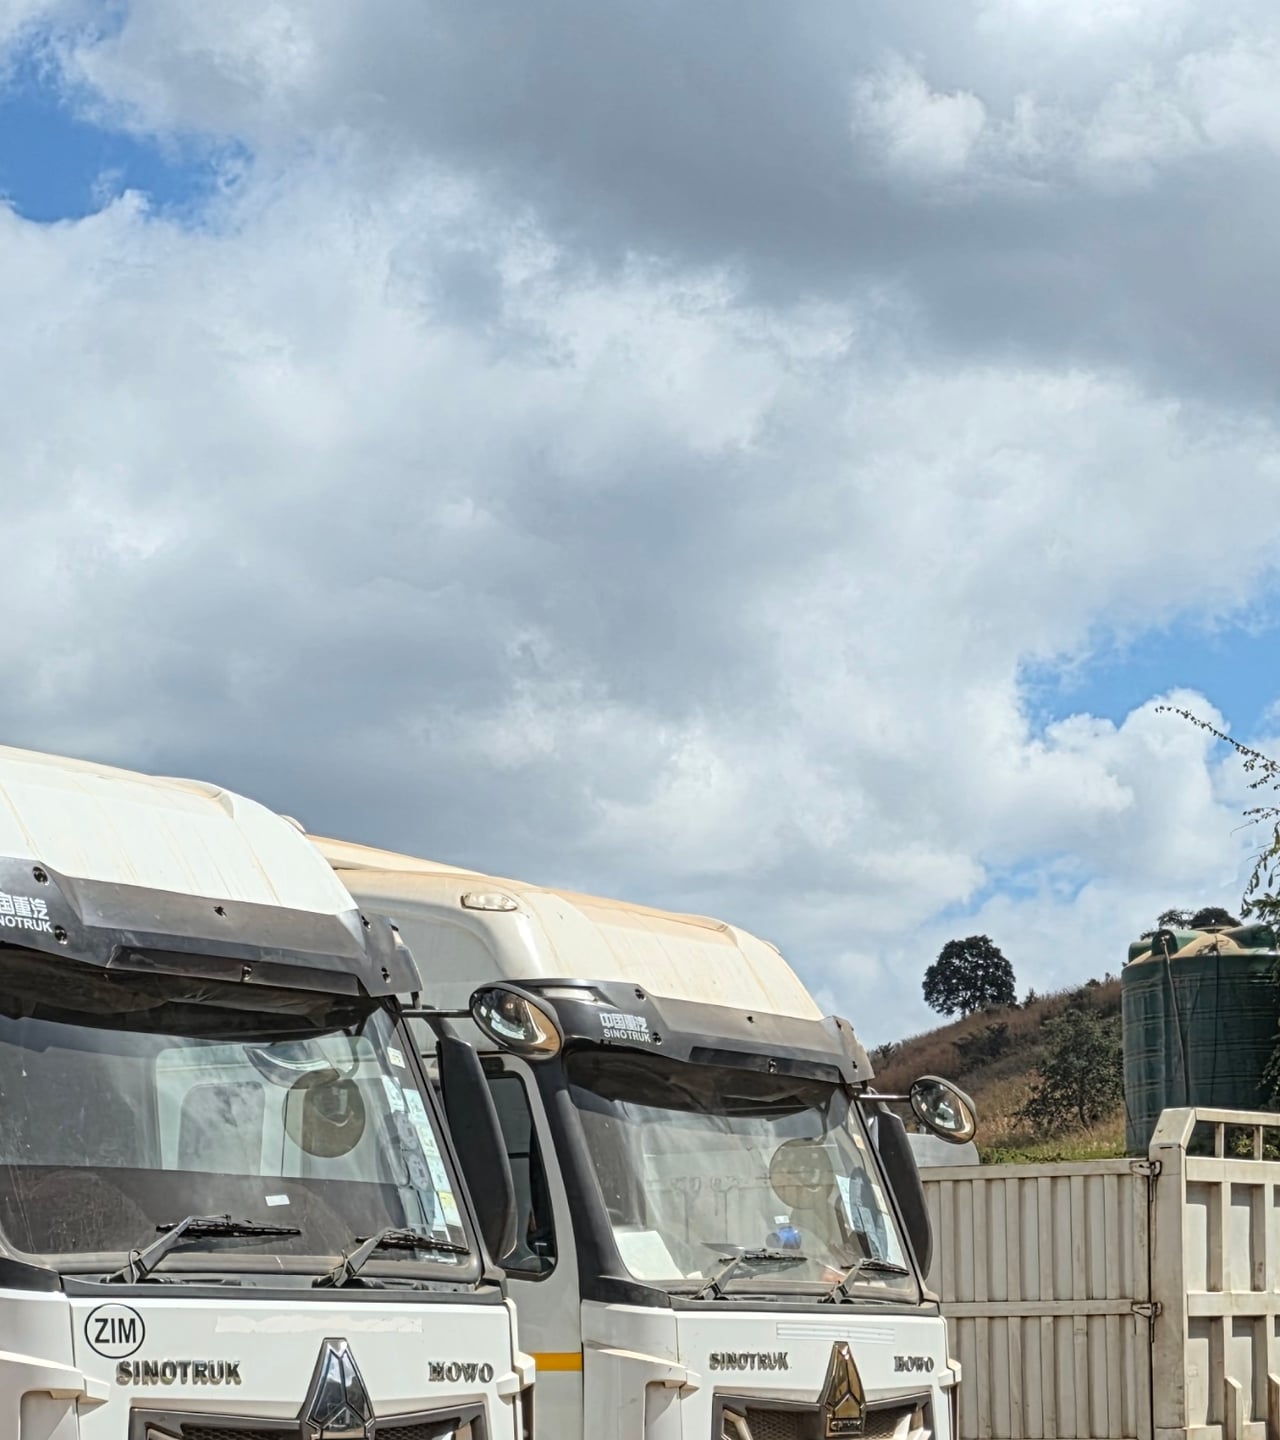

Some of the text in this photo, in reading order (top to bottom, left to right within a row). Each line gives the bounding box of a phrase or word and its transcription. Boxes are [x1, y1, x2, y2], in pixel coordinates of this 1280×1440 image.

[603, 1028, 651, 1043] SINOTRUK
[94, 1317, 137, 1344] ZIM
[115, 1360, 242, 1386] SINOTRUK
[428, 1361, 495, 1384] HOWO
[709, 1352, 789, 1371] SINOTRUK
